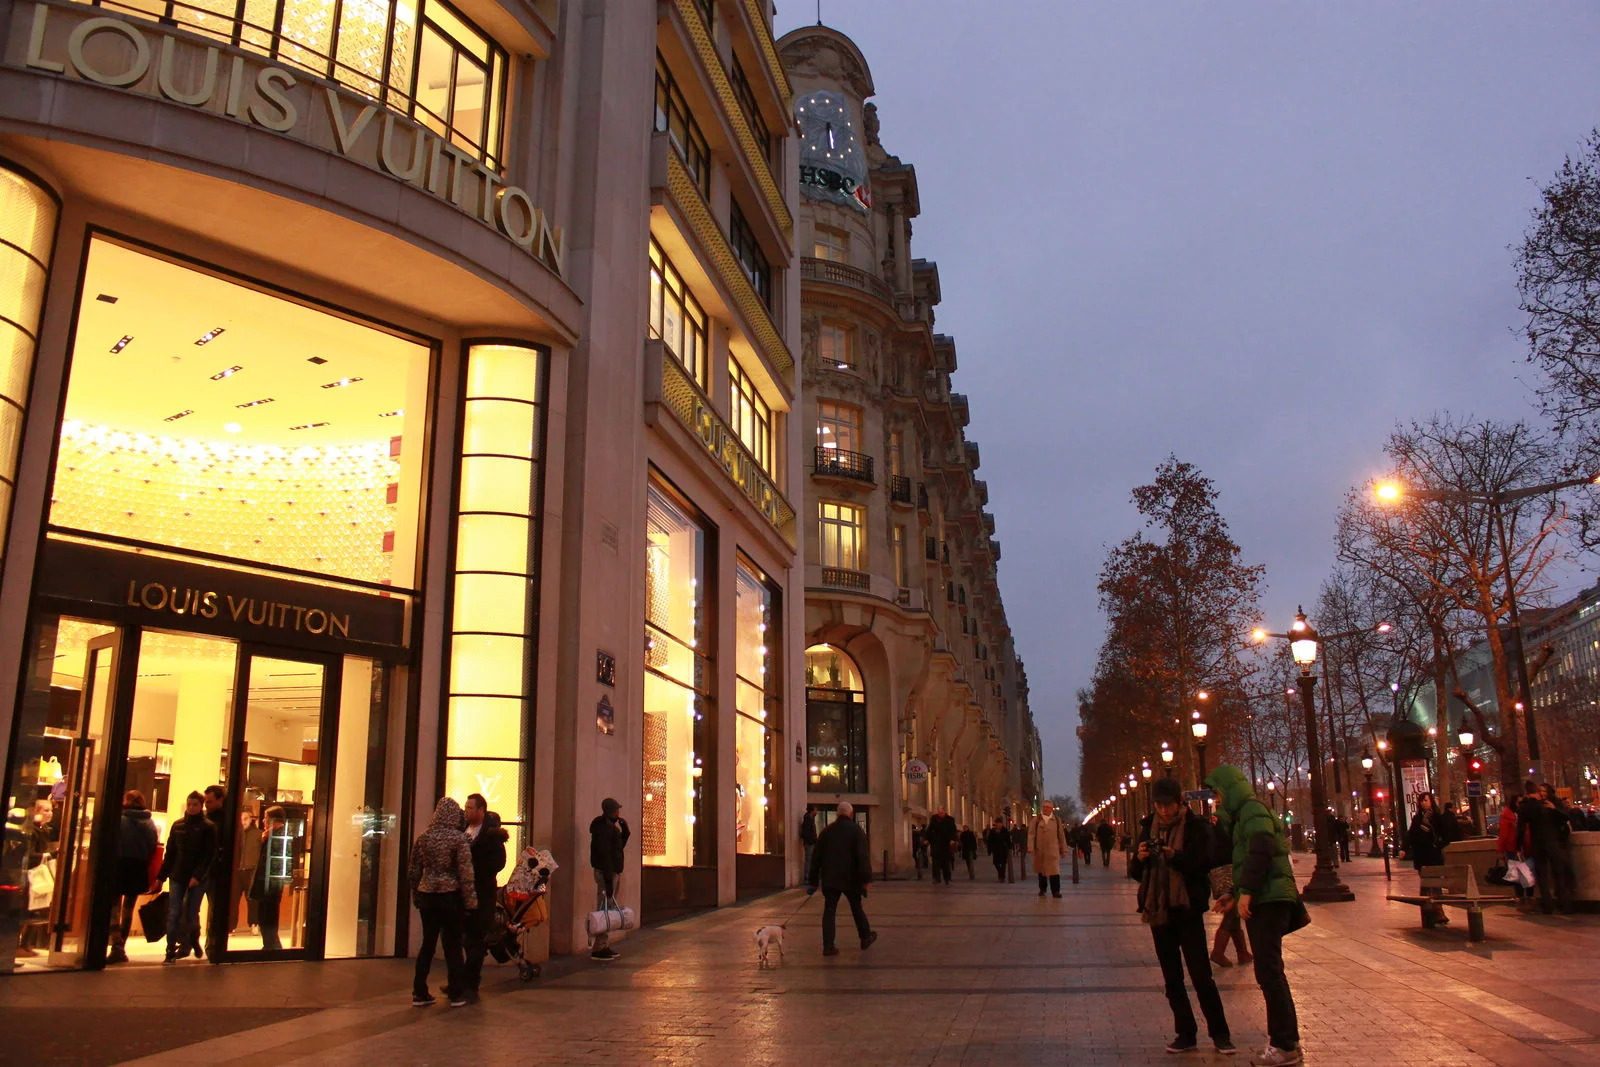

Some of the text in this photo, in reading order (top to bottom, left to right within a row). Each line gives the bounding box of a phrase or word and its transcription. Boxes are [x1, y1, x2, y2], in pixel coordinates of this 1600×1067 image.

[25, 3, 566, 278] LOUIS VUITTON
[799, 164, 856, 195] HSBC
[127, 579, 349, 638] LOUIS VUITTON
